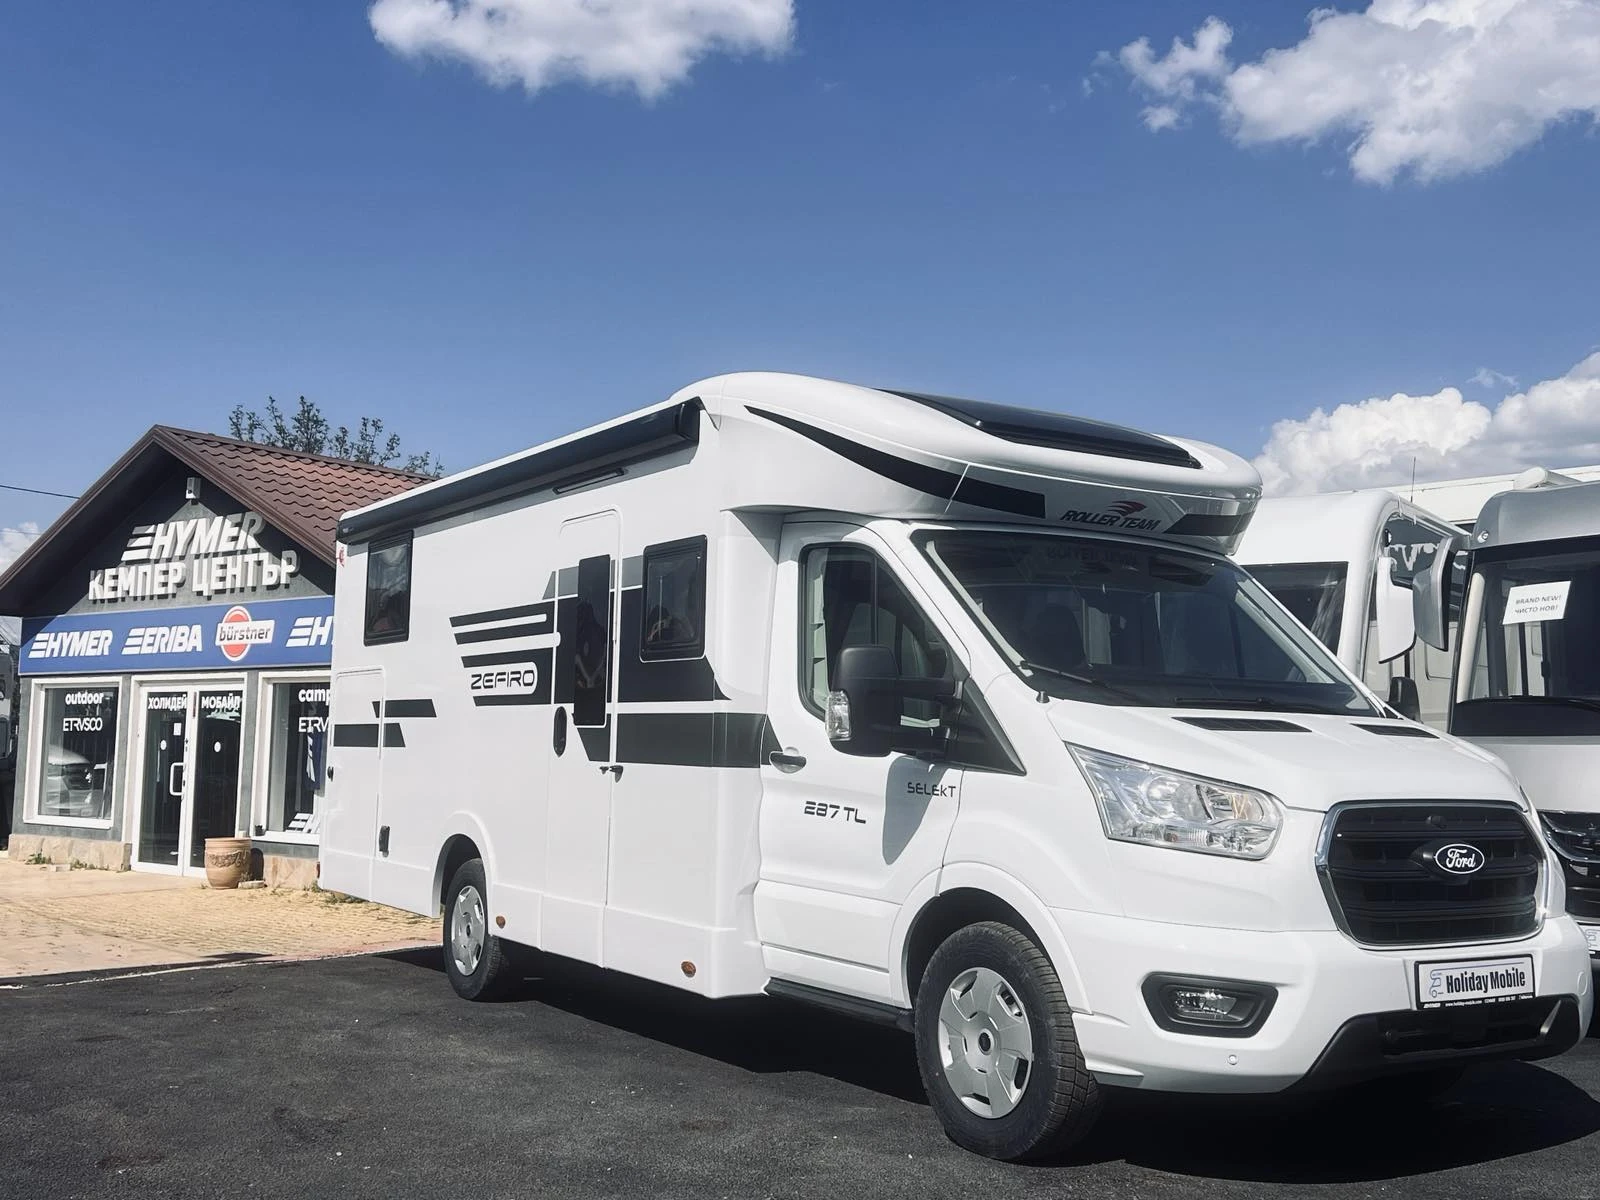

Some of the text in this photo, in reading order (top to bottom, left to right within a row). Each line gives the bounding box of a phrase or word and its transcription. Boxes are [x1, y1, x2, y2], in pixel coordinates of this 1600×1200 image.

[1060, 510, 1162, 531] ROLLER TEAM
[149, 512, 265, 560] HYMER
[88, 550, 300, 600] КЕМПЕР ЦЕНТЪР
[1514, 604, 1559, 614] ЧИСТО НОВ!
[1515, 594, 1562, 604] BRAND NEW!
[143, 624, 203, 654] ERIBA
[219, 623, 272, 642] bürstner
[44, 629, 113, 657] HYMER
[470, 670, 535, 690] ZEFIRO
[65, 691, 104, 705] outdoor
[147, 692, 241, 711] ХОЛИДЕЙ МОБАЙЛ
[843, 806, 866, 824] TL
[1446, 848, 1476, 868] Ford
[1446, 967, 1526, 993] Holiday Mobile
